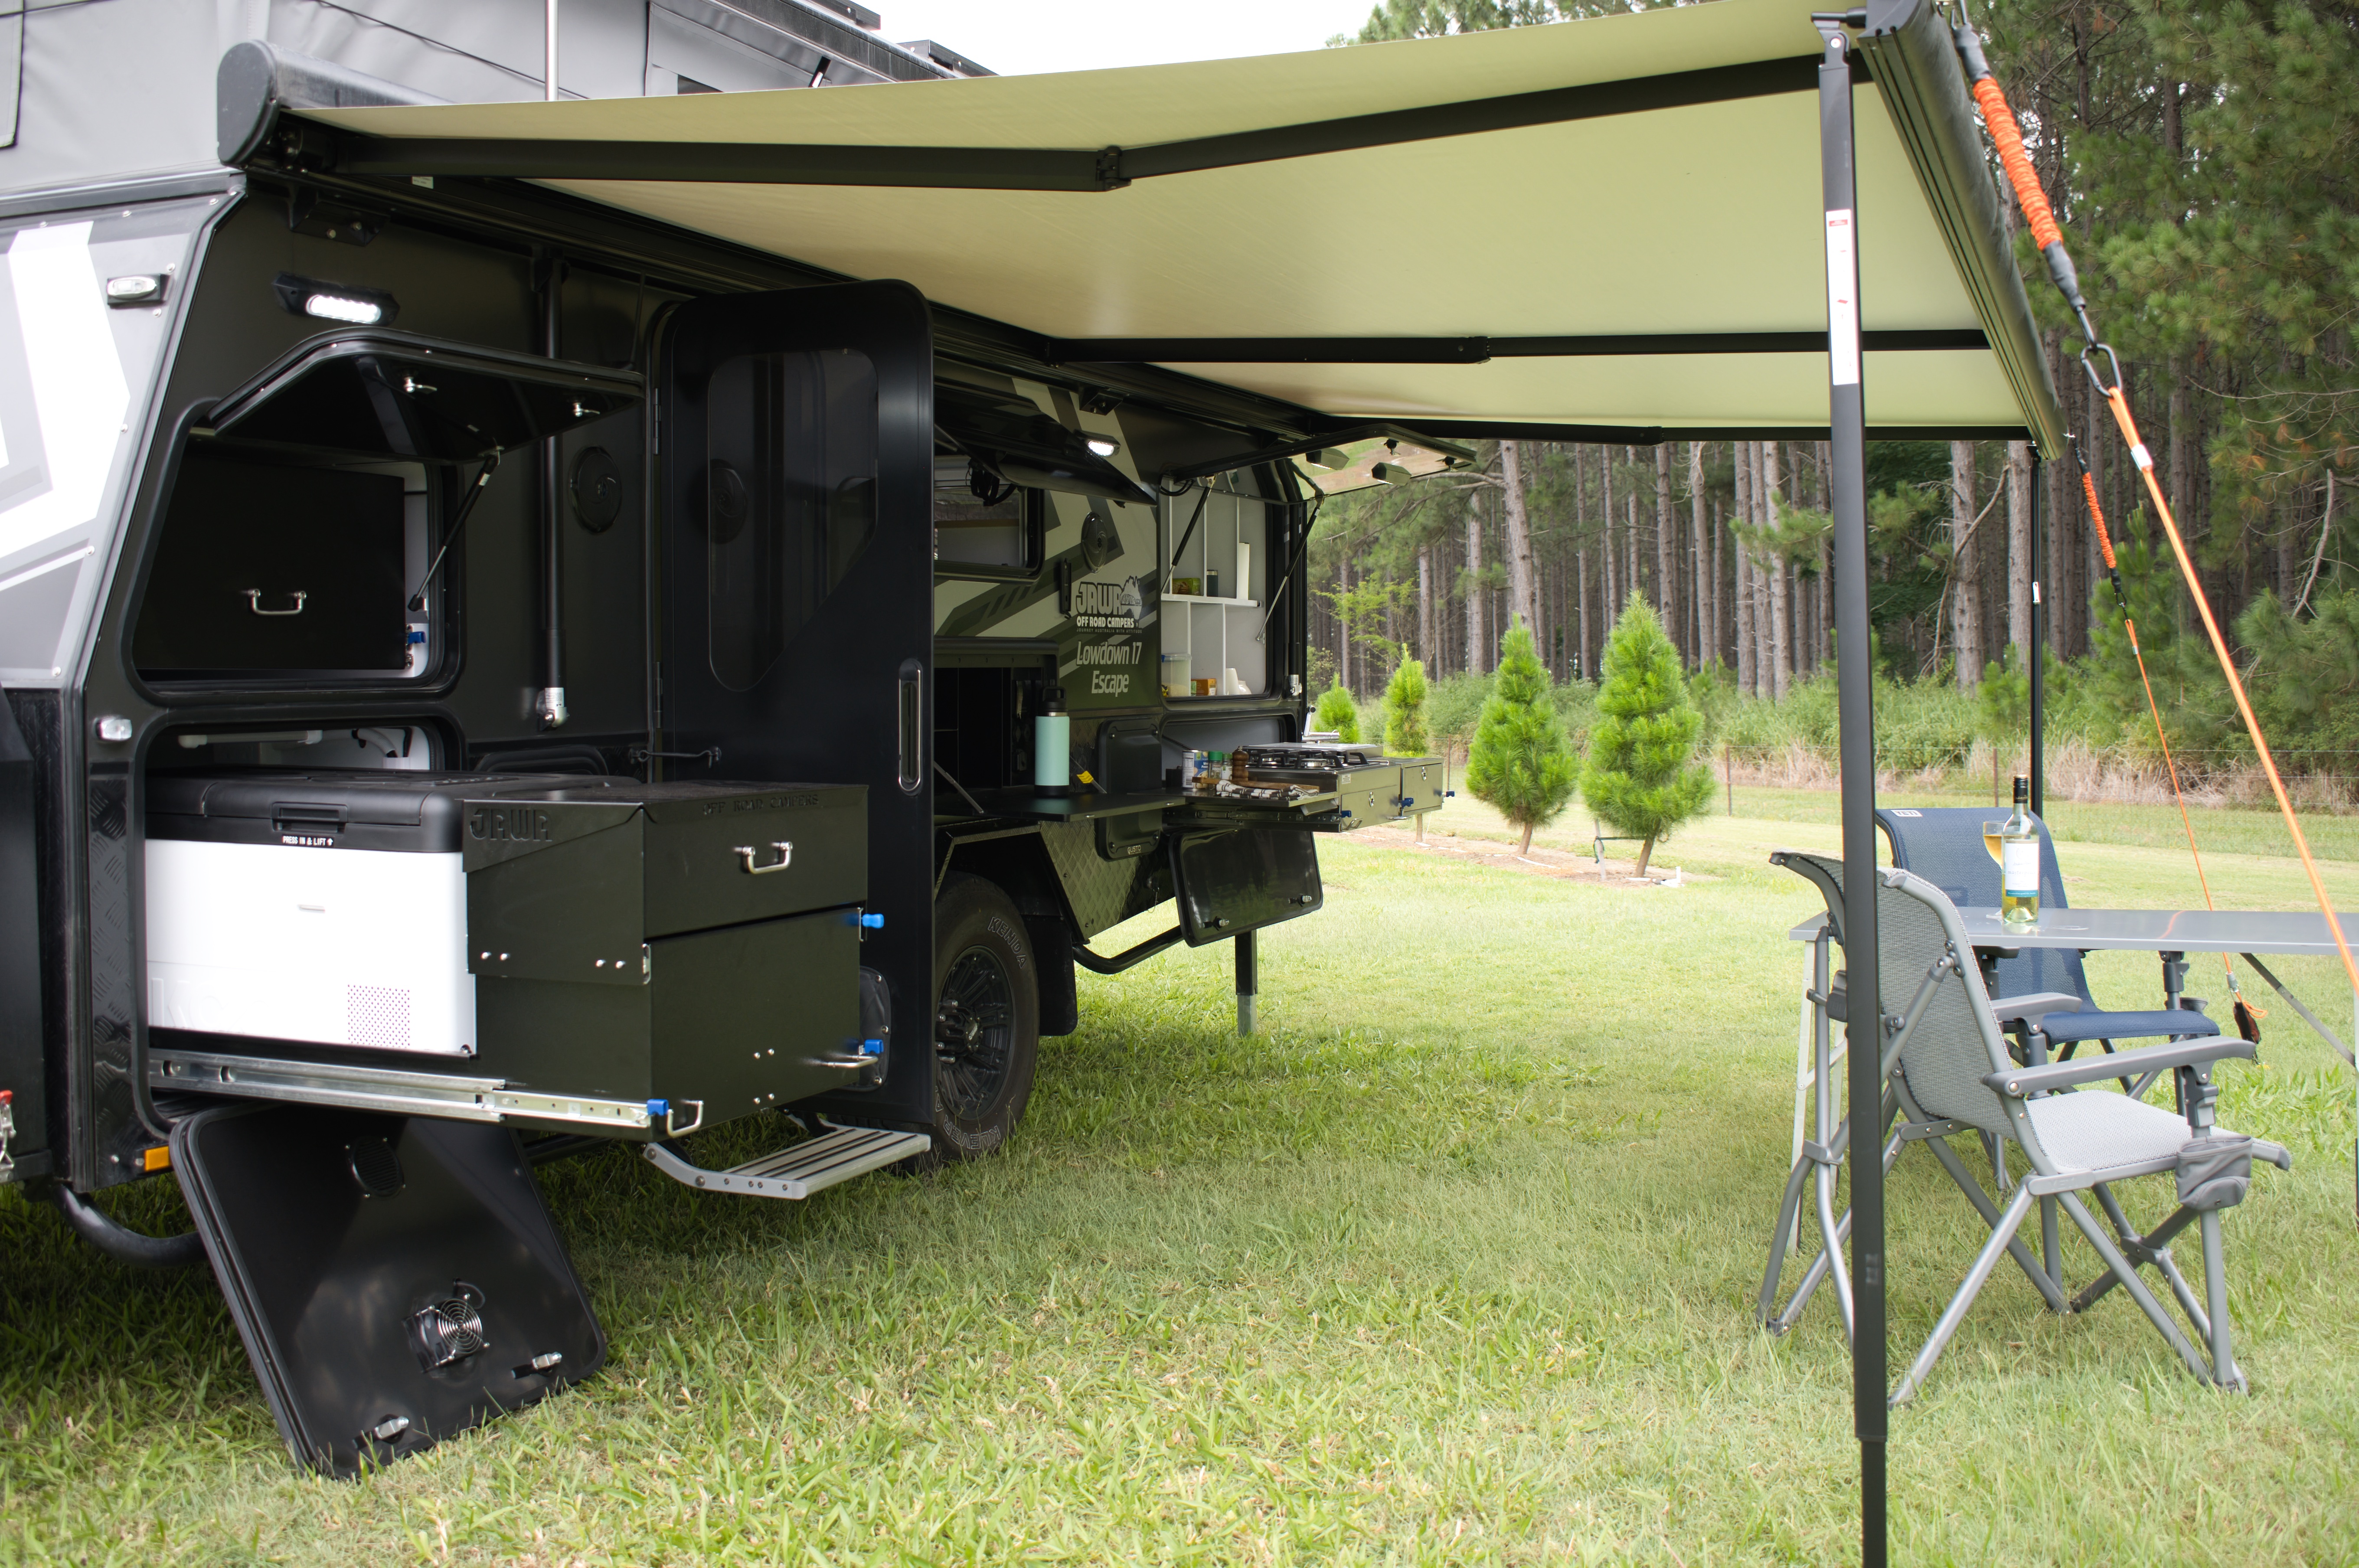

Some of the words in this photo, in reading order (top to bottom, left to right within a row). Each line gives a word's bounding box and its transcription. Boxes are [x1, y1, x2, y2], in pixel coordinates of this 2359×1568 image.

[1077, 616, 1088, 627] OFF
[1090, 617, 1106, 627] ROAD
[1107, 617, 1134, 628] CAMPERS
[1076, 641, 1130, 665] Lowdown
[1132, 642, 1142, 664] 17
[1091, 670, 1129, 697] Escape
[703, 801, 725, 815] OFF
[734, 799, 763, 812] ROAD
[770, 794, 818, 808] CAMPERS
[282, 835, 298, 844] PRESS
[299, 836, 306, 845] IN
[306, 836, 312, 846] &
[313, 837, 326, 846] LIFT
[1127, 845, 1141, 855] GUSTO
[987, 916, 1027, 969] KENDA
[943, 1114, 1001, 1150] KLEVER
